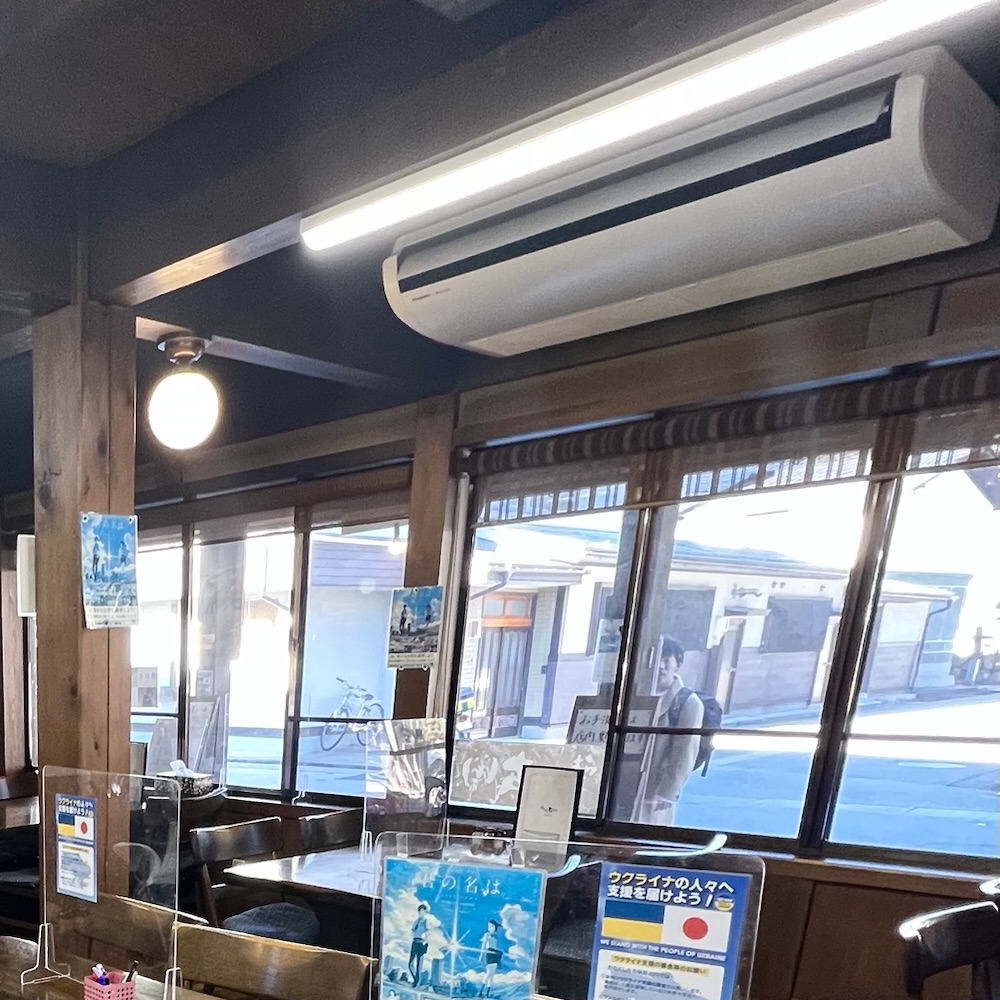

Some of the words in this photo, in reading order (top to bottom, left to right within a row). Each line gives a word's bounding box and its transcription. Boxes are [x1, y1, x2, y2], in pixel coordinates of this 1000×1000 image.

[608, 871, 734, 893] ウクライナの人々へ
[648, 943, 660, 952] THE
[661, 945, 684, 956] PEOPLE
[686, 949, 695, 957] OF
[697, 951, 726, 962] UKRAINE
